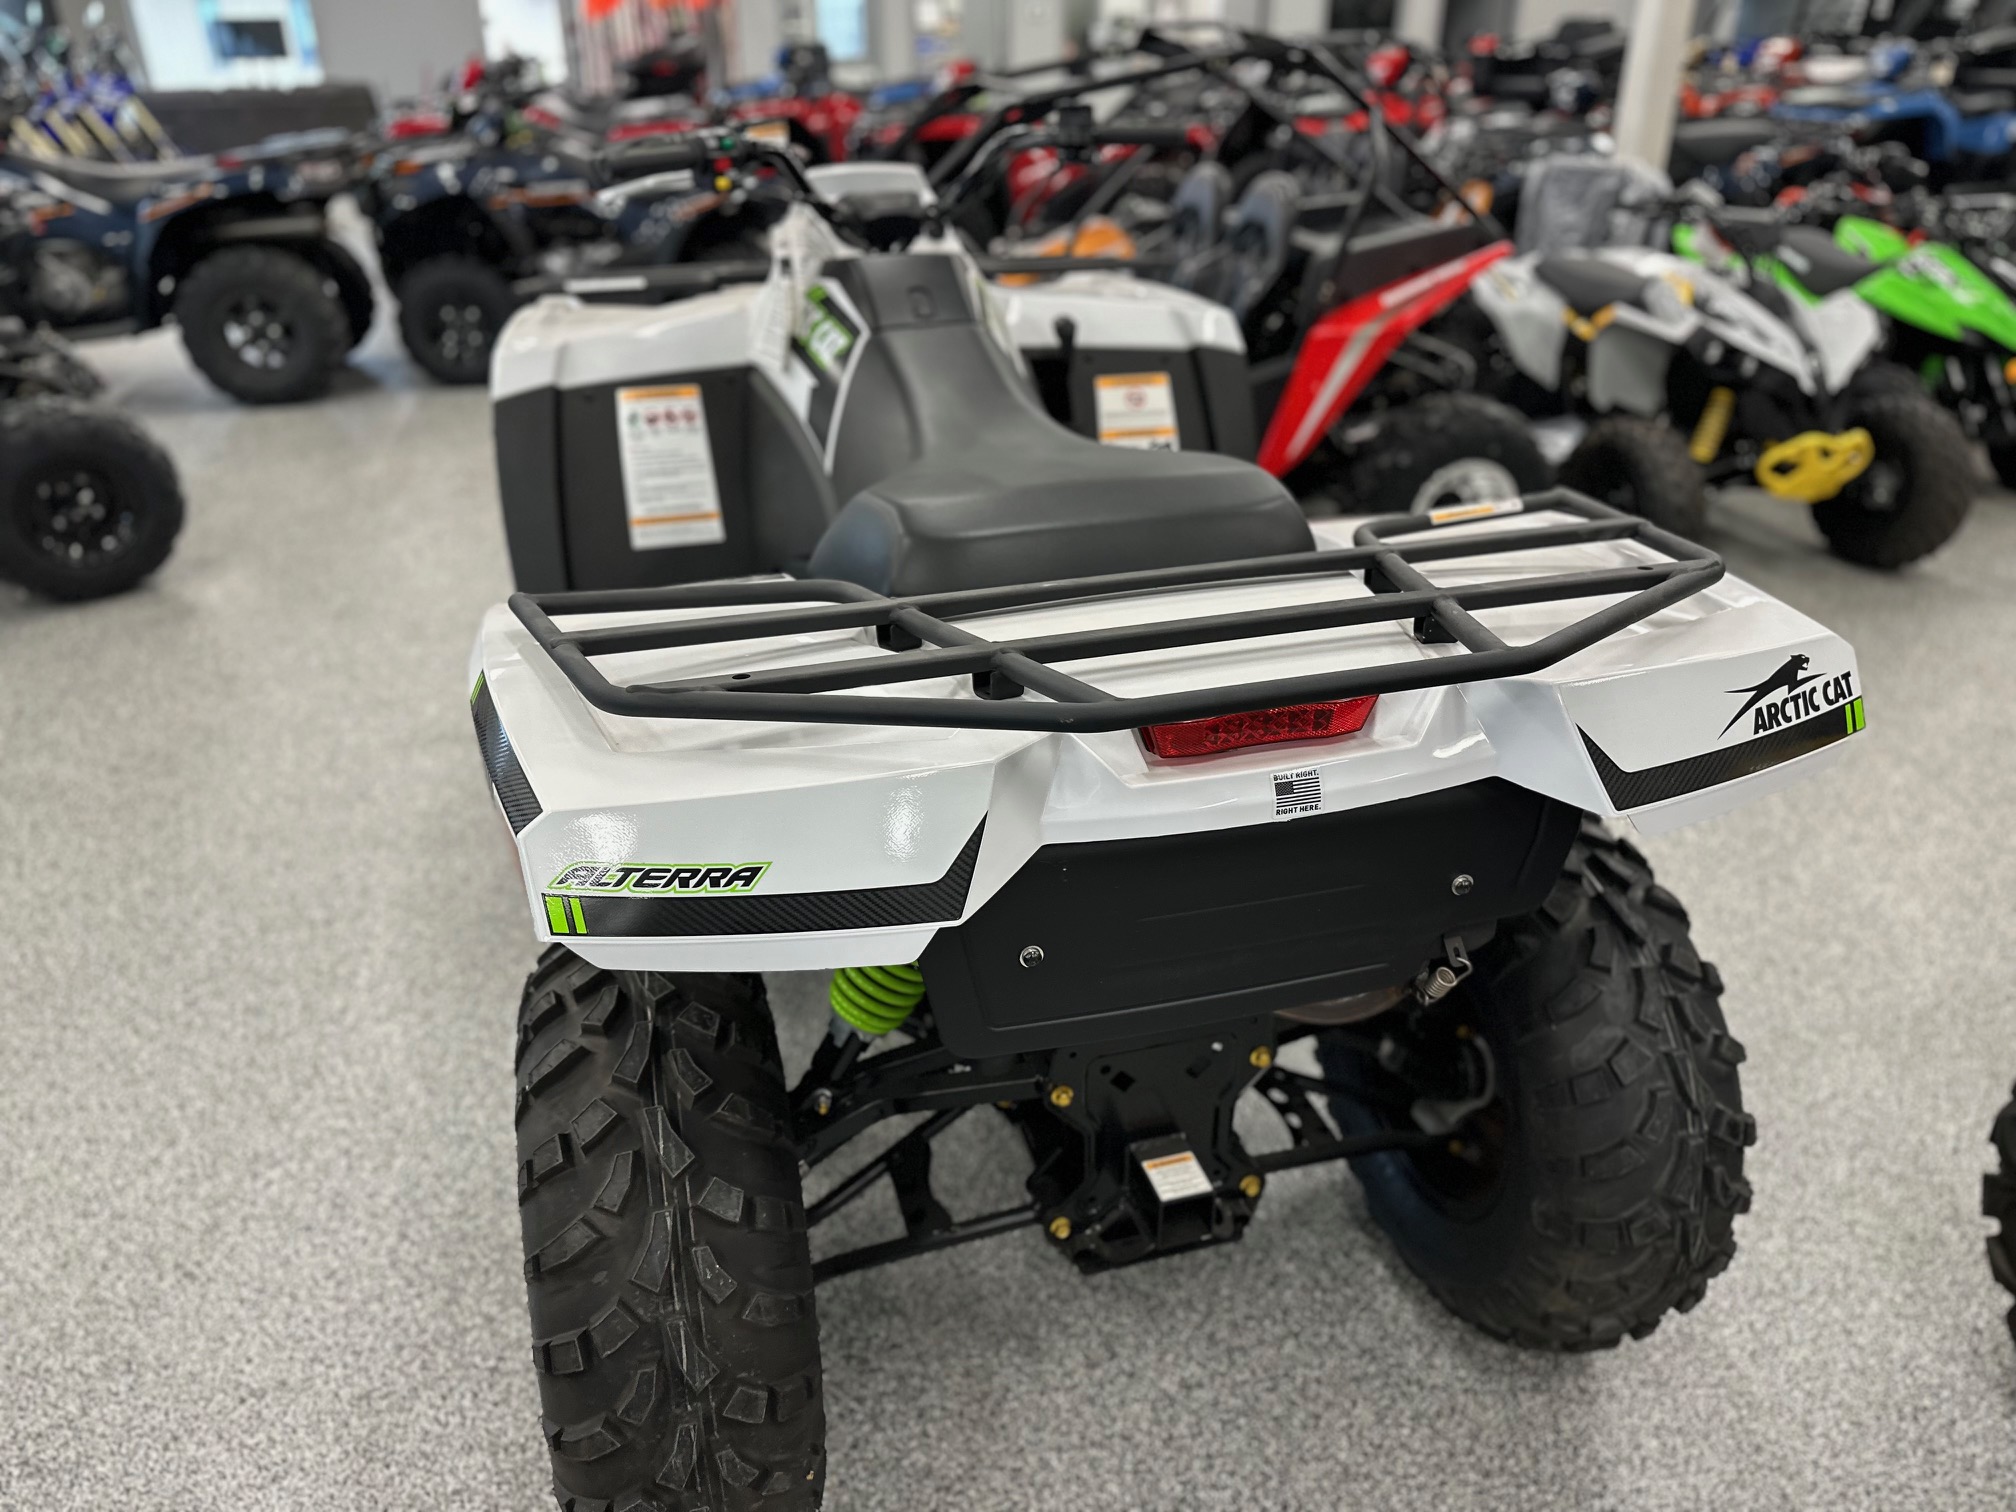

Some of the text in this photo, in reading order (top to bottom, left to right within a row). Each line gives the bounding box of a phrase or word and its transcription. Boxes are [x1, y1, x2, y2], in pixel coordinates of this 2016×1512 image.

[1753, 671, 1853, 735] ARCTIC CAT
[1273, 769, 1319, 781] BUILT RIGHT.
[1276, 804, 1321, 815] RIGHT HERE.
[553, 864, 768, 891] ALTERRA
